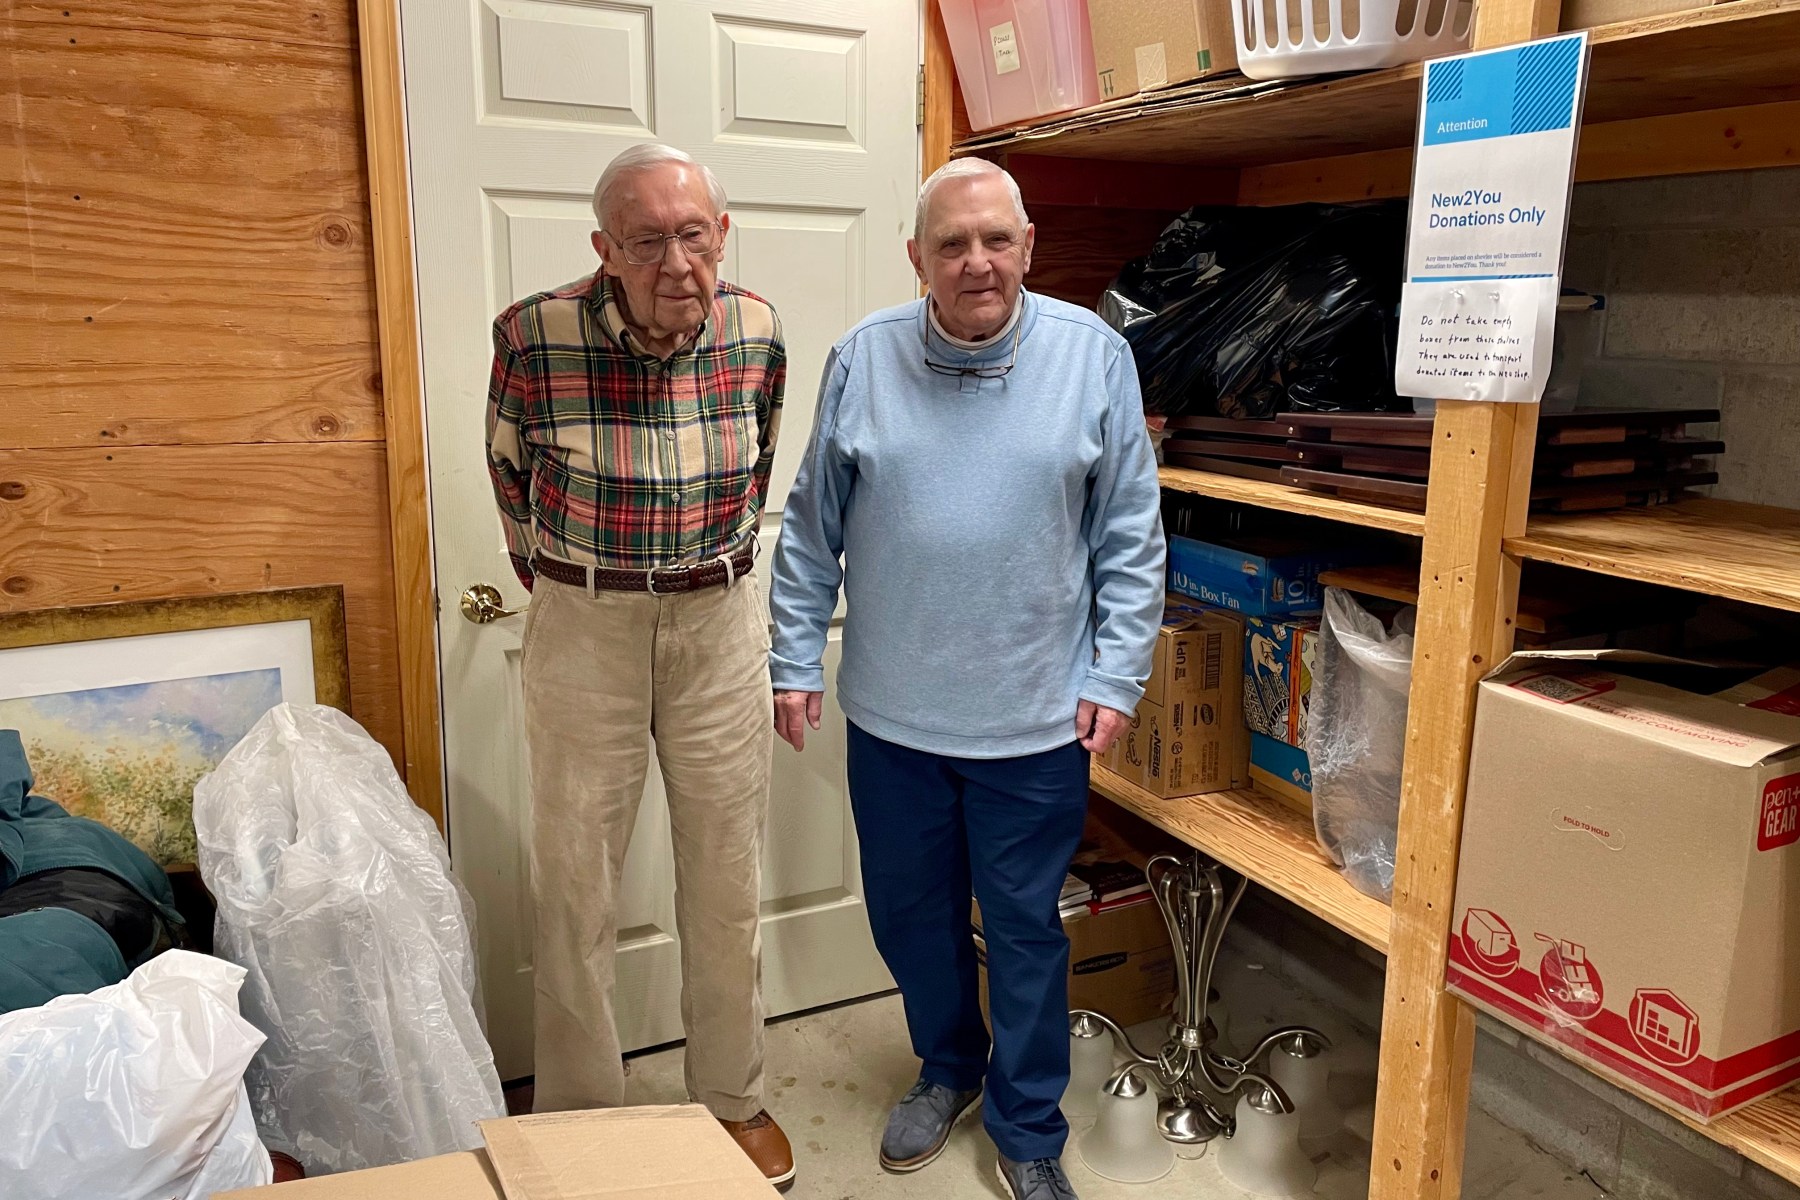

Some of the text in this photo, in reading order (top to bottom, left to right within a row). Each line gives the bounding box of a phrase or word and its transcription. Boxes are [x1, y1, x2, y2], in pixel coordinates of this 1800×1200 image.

[1437, 118, 1488, 134] Attention
[1431, 189, 1502, 208] New2You
[1429, 206, 1546, 229] Donations Only
[1450, 254, 1466, 262] placed
[1421, 316, 1434, 326] Do
[1440, 314, 1460, 324] not
[1466, 315, 1488, 326] take
[1420, 334, 1442, 344] boxes
[1448, 334, 1470, 345] from
[1419, 349, 1438, 362] They
[1460, 352, 1480, 361] used
[1484, 352, 1490, 361] to
[1416, 366, 1447, 376] donated
[1450, 368, 1474, 377] items
[1173, 570, 1188, 588] 10
[1201, 585, 1220, 603] Box
[1222, 591, 1240, 610] Fan
[1176, 649, 1186, 665] UP
[1564, 816, 1610, 838] FOLD TO HOLD
[1766, 805, 1797, 838] GEAR
